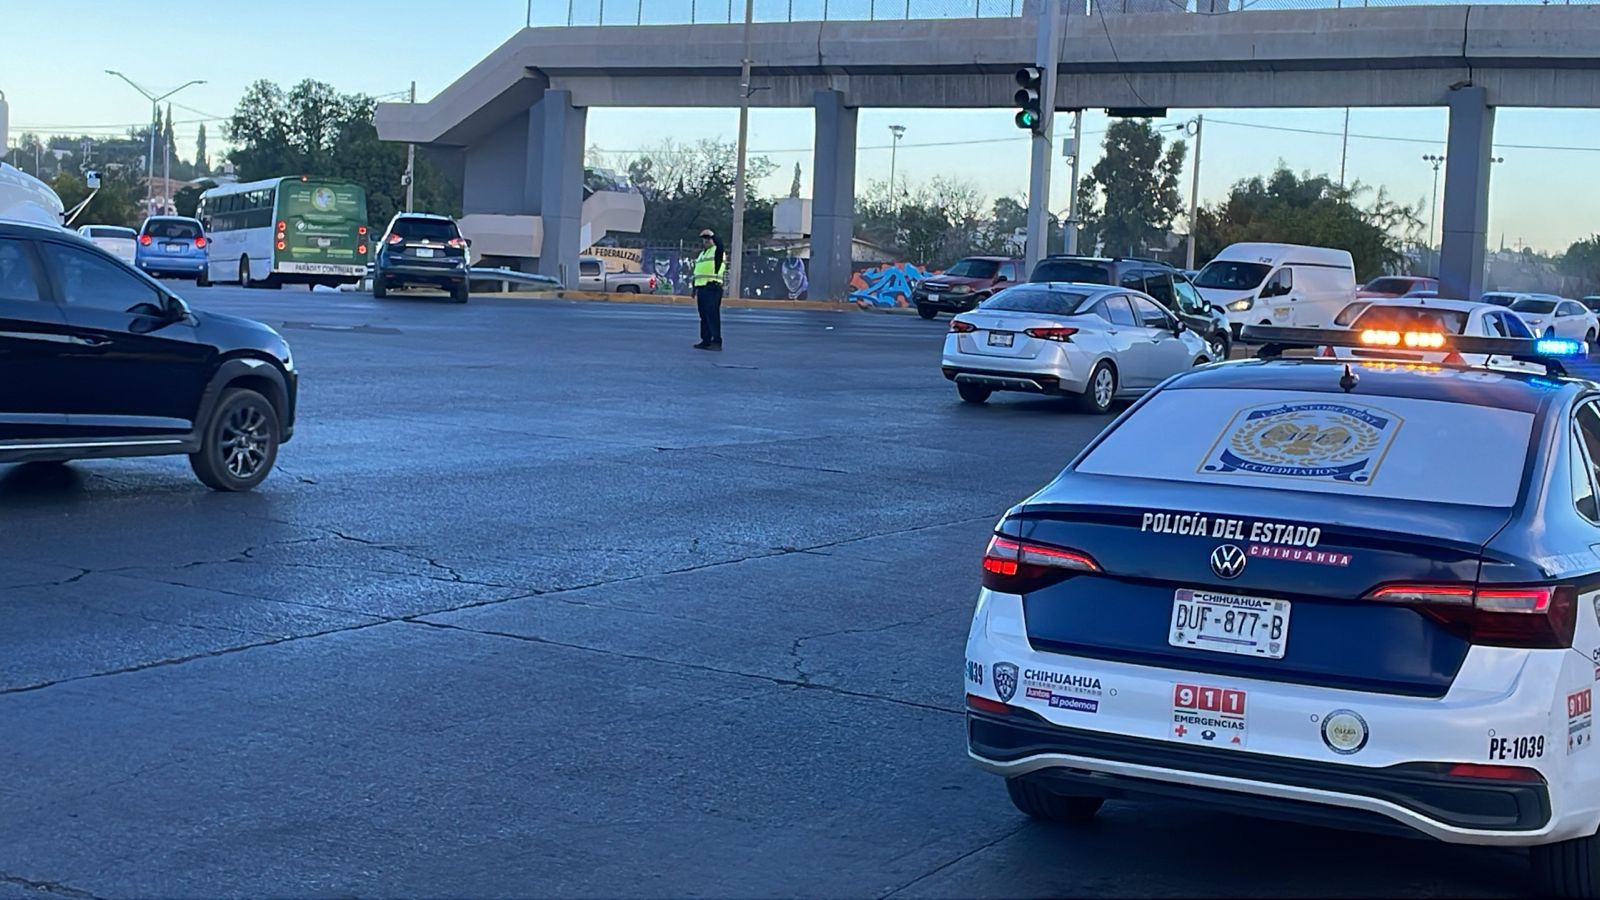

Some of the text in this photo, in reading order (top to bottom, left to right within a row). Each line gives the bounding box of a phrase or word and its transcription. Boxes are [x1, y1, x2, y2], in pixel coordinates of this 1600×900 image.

[1237, 462, 1339, 475] ACCREDITATION
[1141, 512, 1321, 548] POLICÍA DEL ESTADO
[1250, 546, 1349, 565] CHIHUAHUA
[1202, 594, 1262, 608] CHIHUAHUA
[1024, 668, 1101, 690] CHIHUAHUA
[1027, 688, 1051, 699] Juntos
[1180, 688, 1239, 711] 911
[1568, 691, 1590, 715] 911
[1059, 697, 1096, 711] podemos
[1174, 714, 1245, 730] EMERGENCIAS
[1489, 735, 1545, 760] PE-1039
